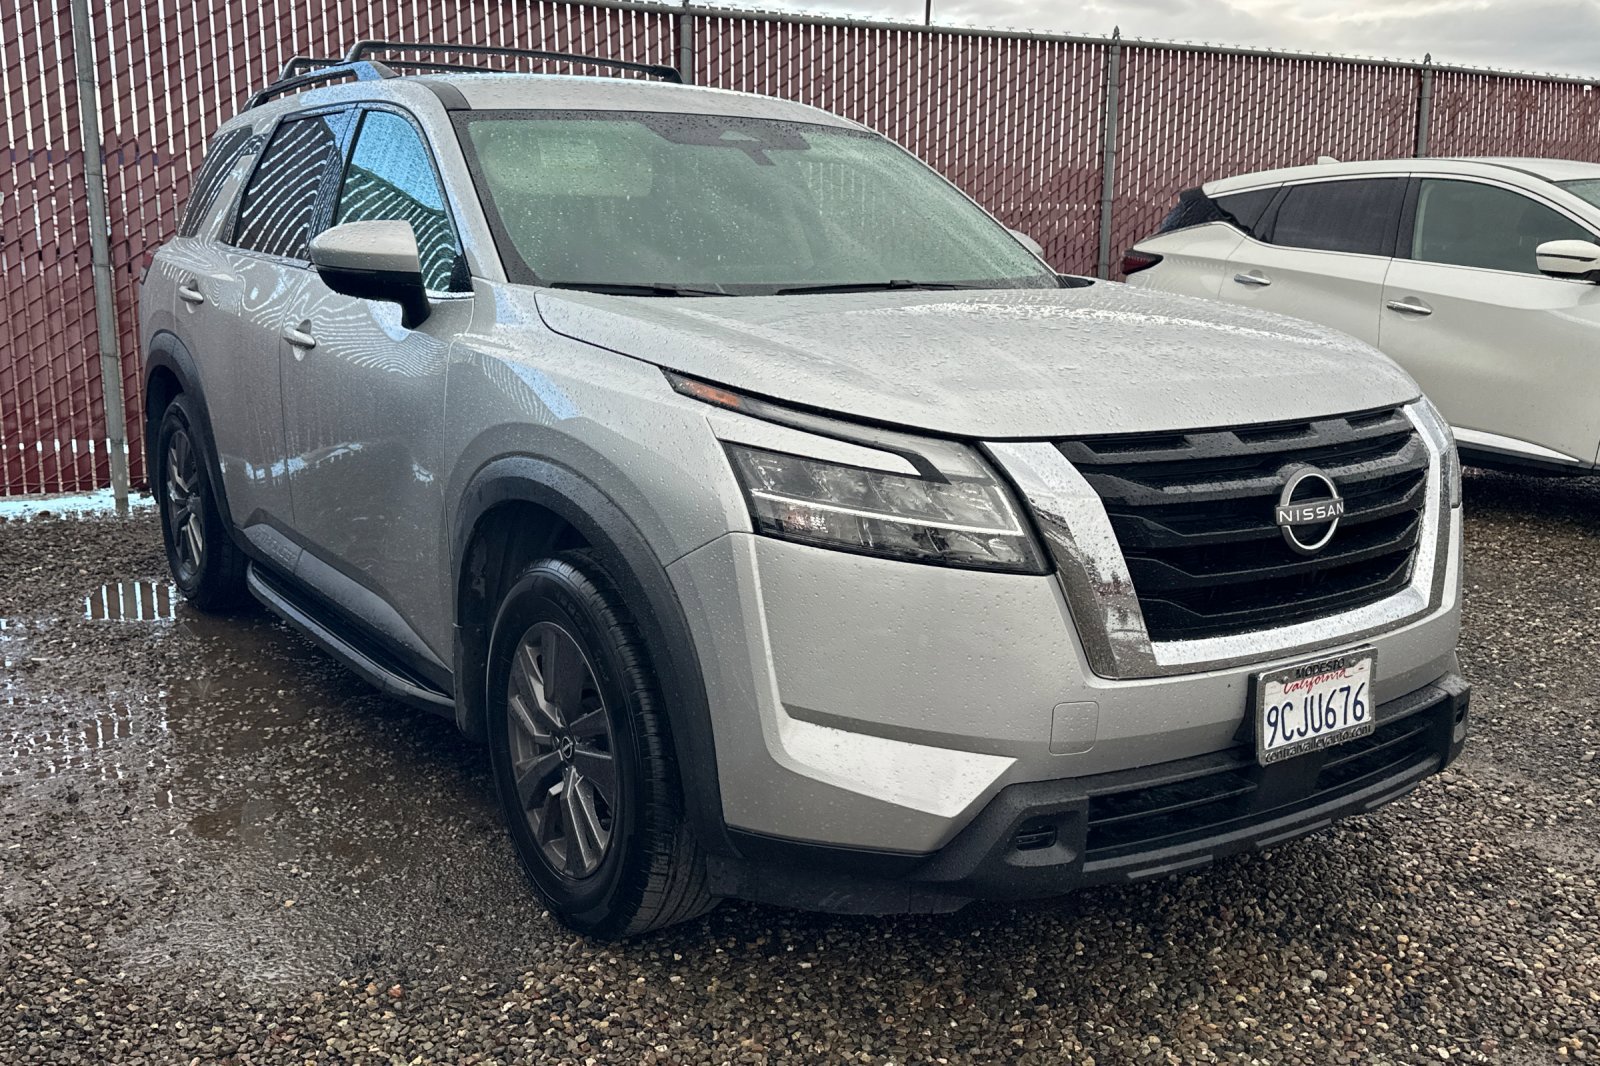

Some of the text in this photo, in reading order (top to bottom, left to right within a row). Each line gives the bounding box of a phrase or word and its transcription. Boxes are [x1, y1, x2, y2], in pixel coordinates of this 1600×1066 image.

[1279, 501, 1343, 522] NISSAN
[1296, 658, 1345, 678] MODESTO
[1283, 668, 1353, 694] California
[1266, 682, 1366, 748] 9CJU676
